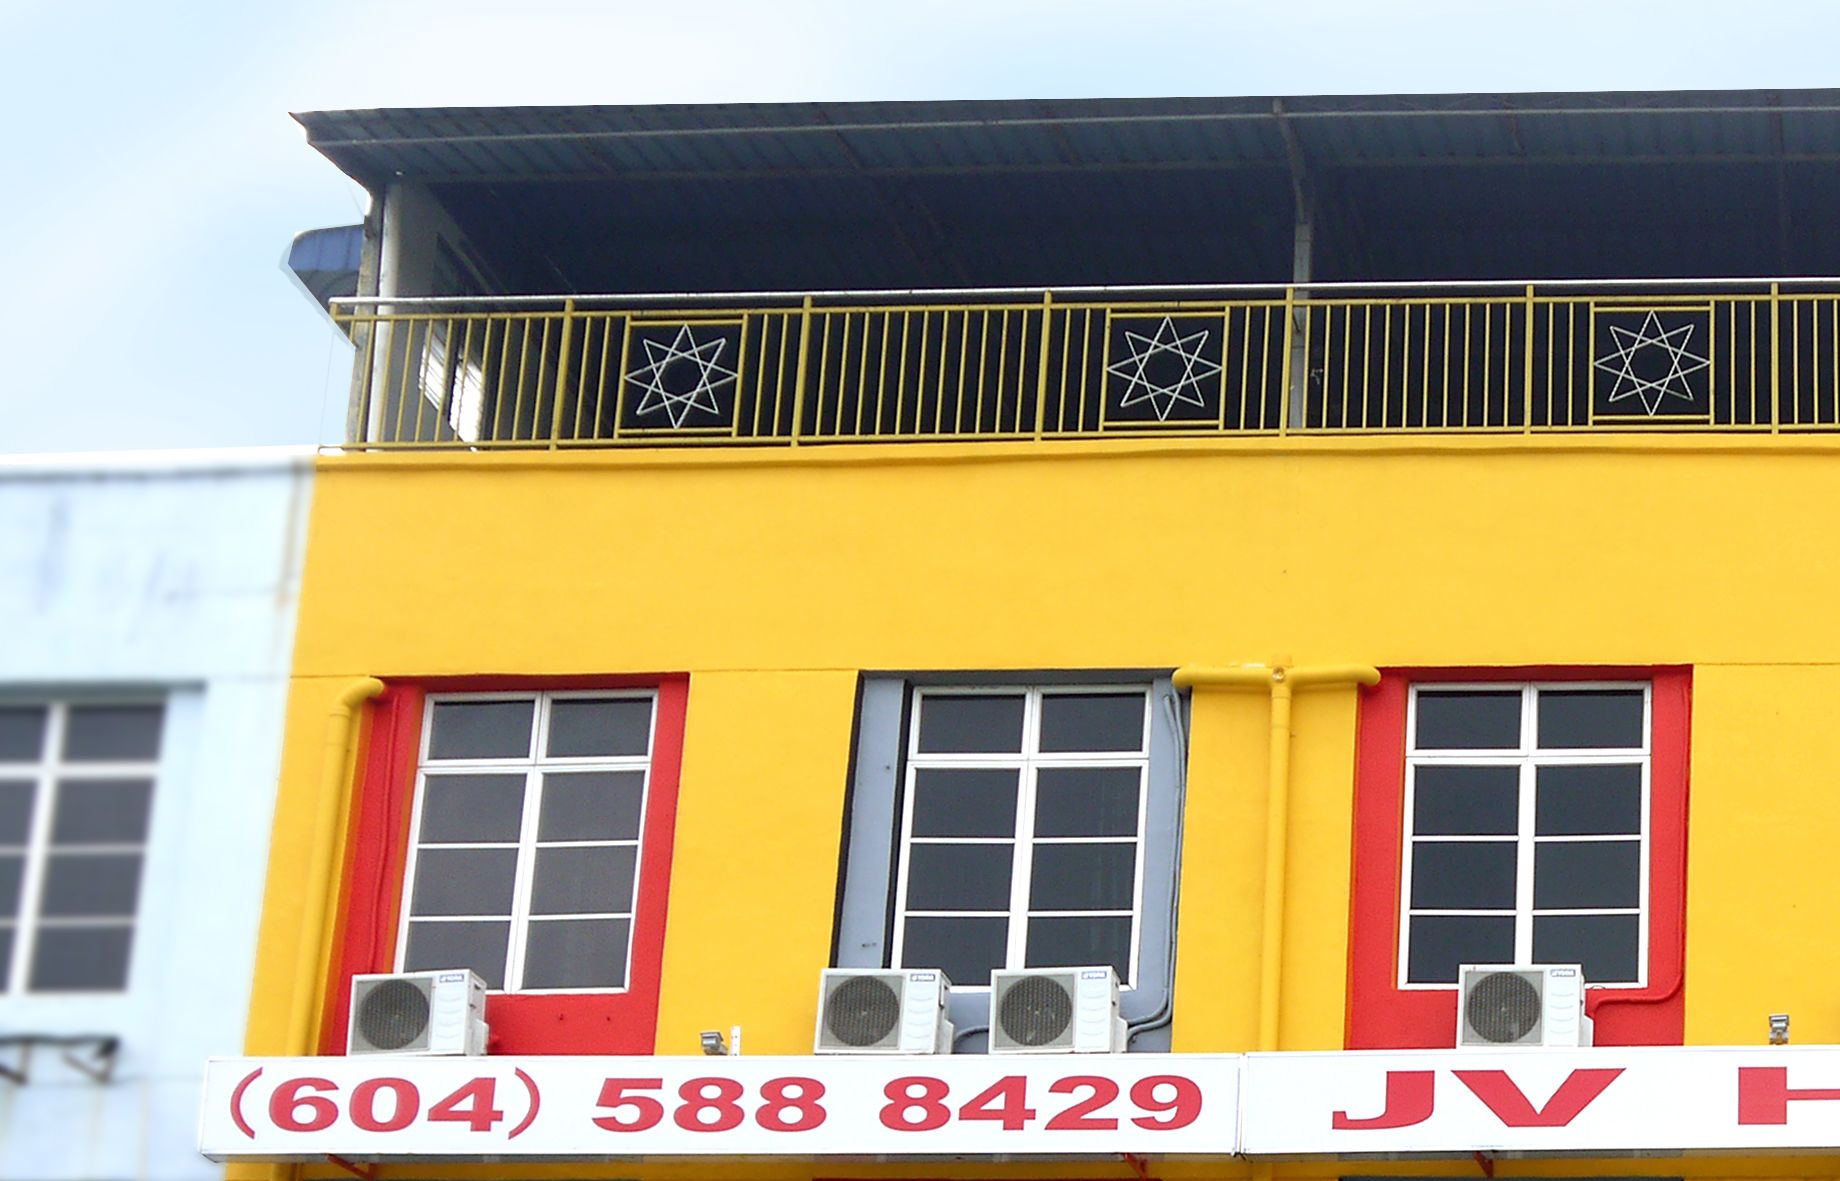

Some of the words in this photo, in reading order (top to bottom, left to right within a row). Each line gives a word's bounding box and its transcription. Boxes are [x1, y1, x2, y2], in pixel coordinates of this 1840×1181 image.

[230, 1067, 541, 1140] (604)
[593, 1075, 828, 1134] 588
[878, 1073, 1204, 1135] 8429
[1331, 1066, 1627, 1132] JV
